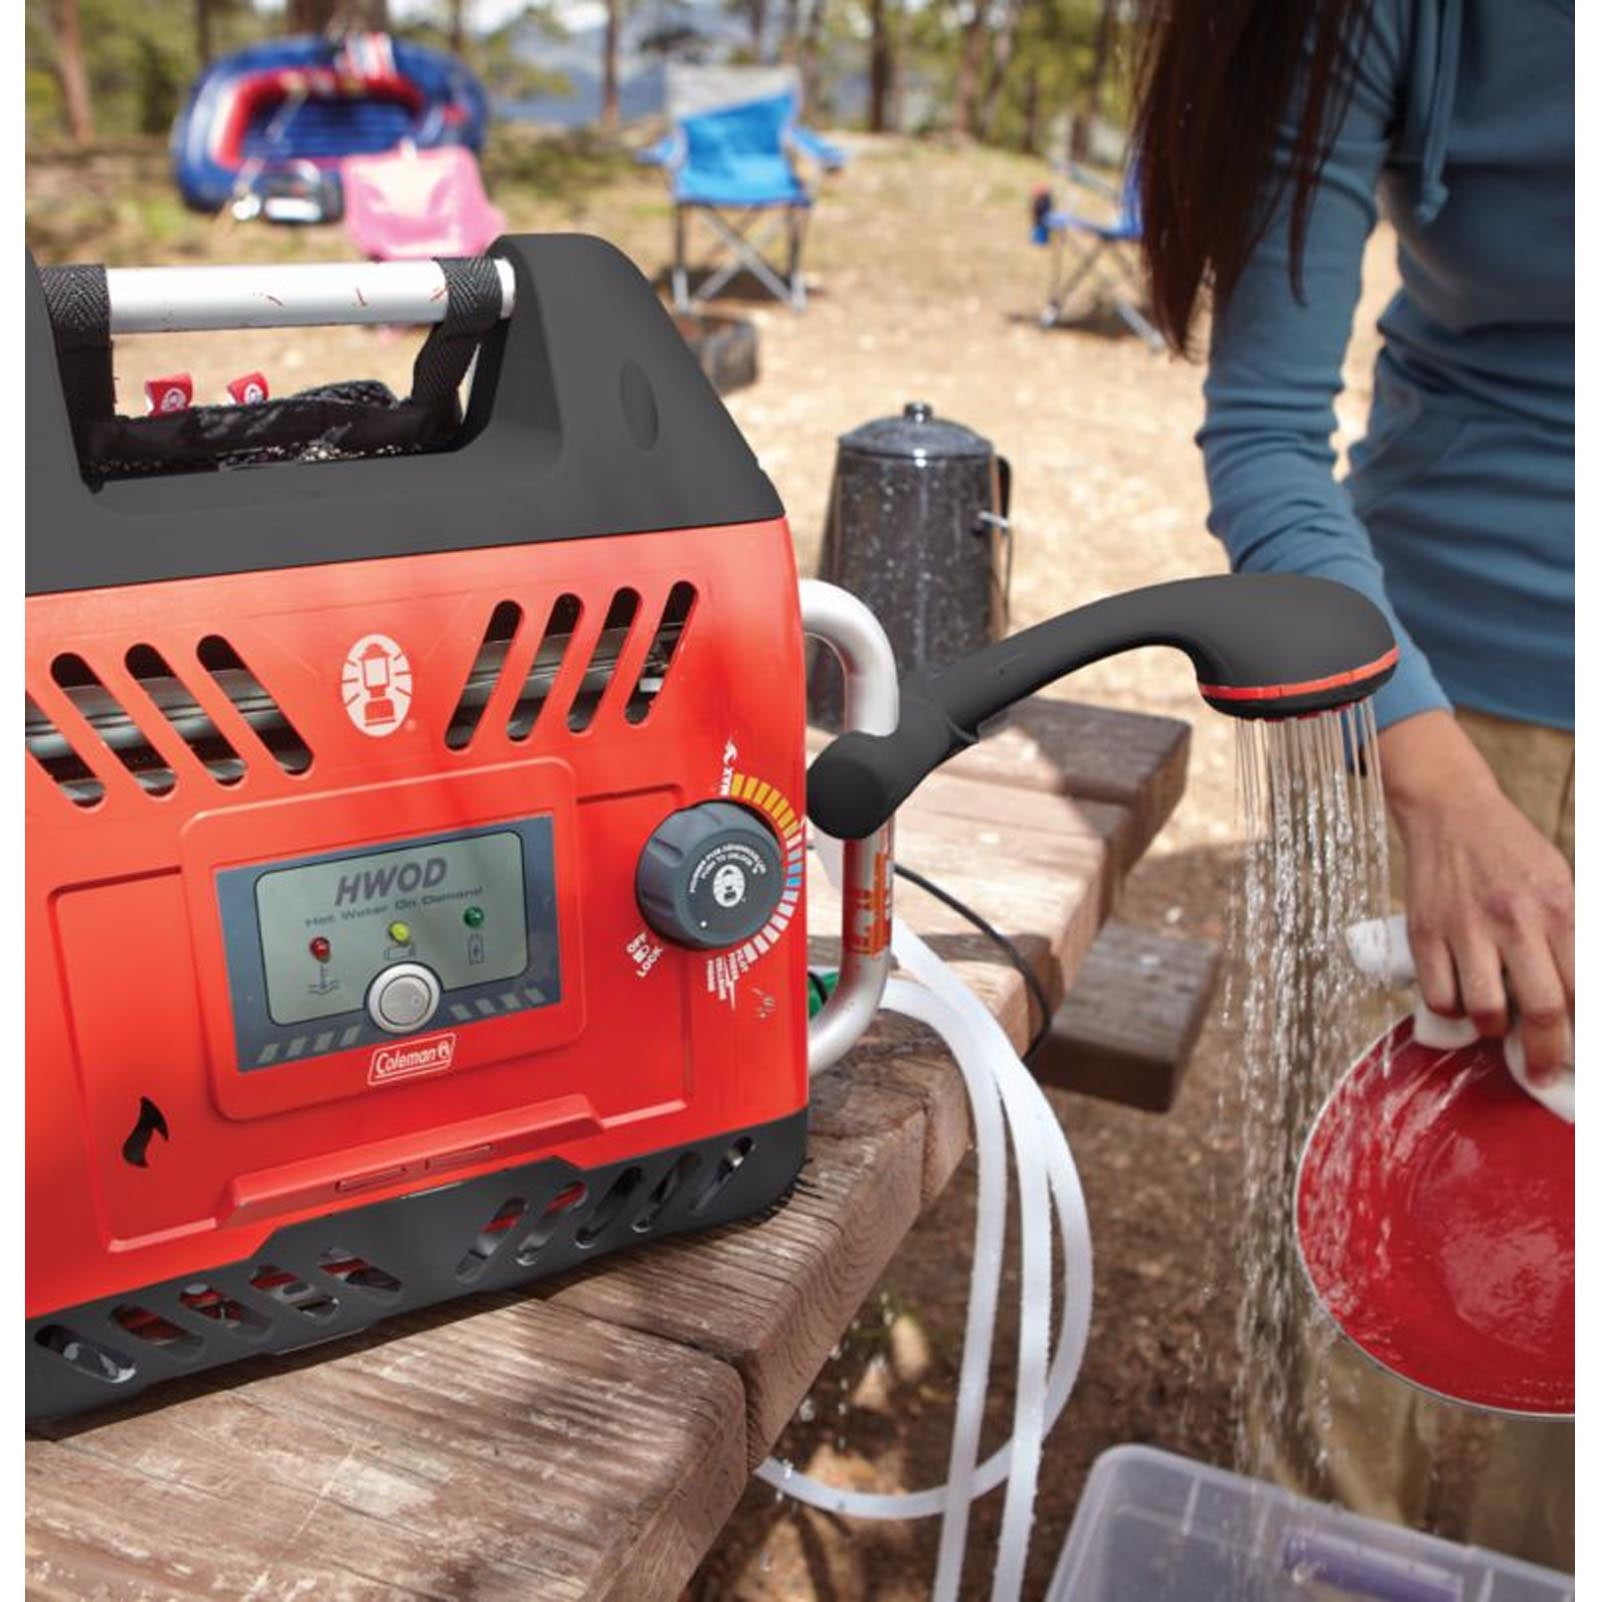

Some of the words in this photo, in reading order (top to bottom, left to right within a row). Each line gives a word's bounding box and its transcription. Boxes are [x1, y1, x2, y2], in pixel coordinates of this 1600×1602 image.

[334, 857, 448, 906] HWOD
[305, 914, 335, 926] Hot
[341, 904, 389, 921] Water
[395, 898, 417, 911] On
[420, 886, 484, 906] Demand
[636, 945, 664, 979] LOCK
[375, 1047, 437, 1075] Coleman
